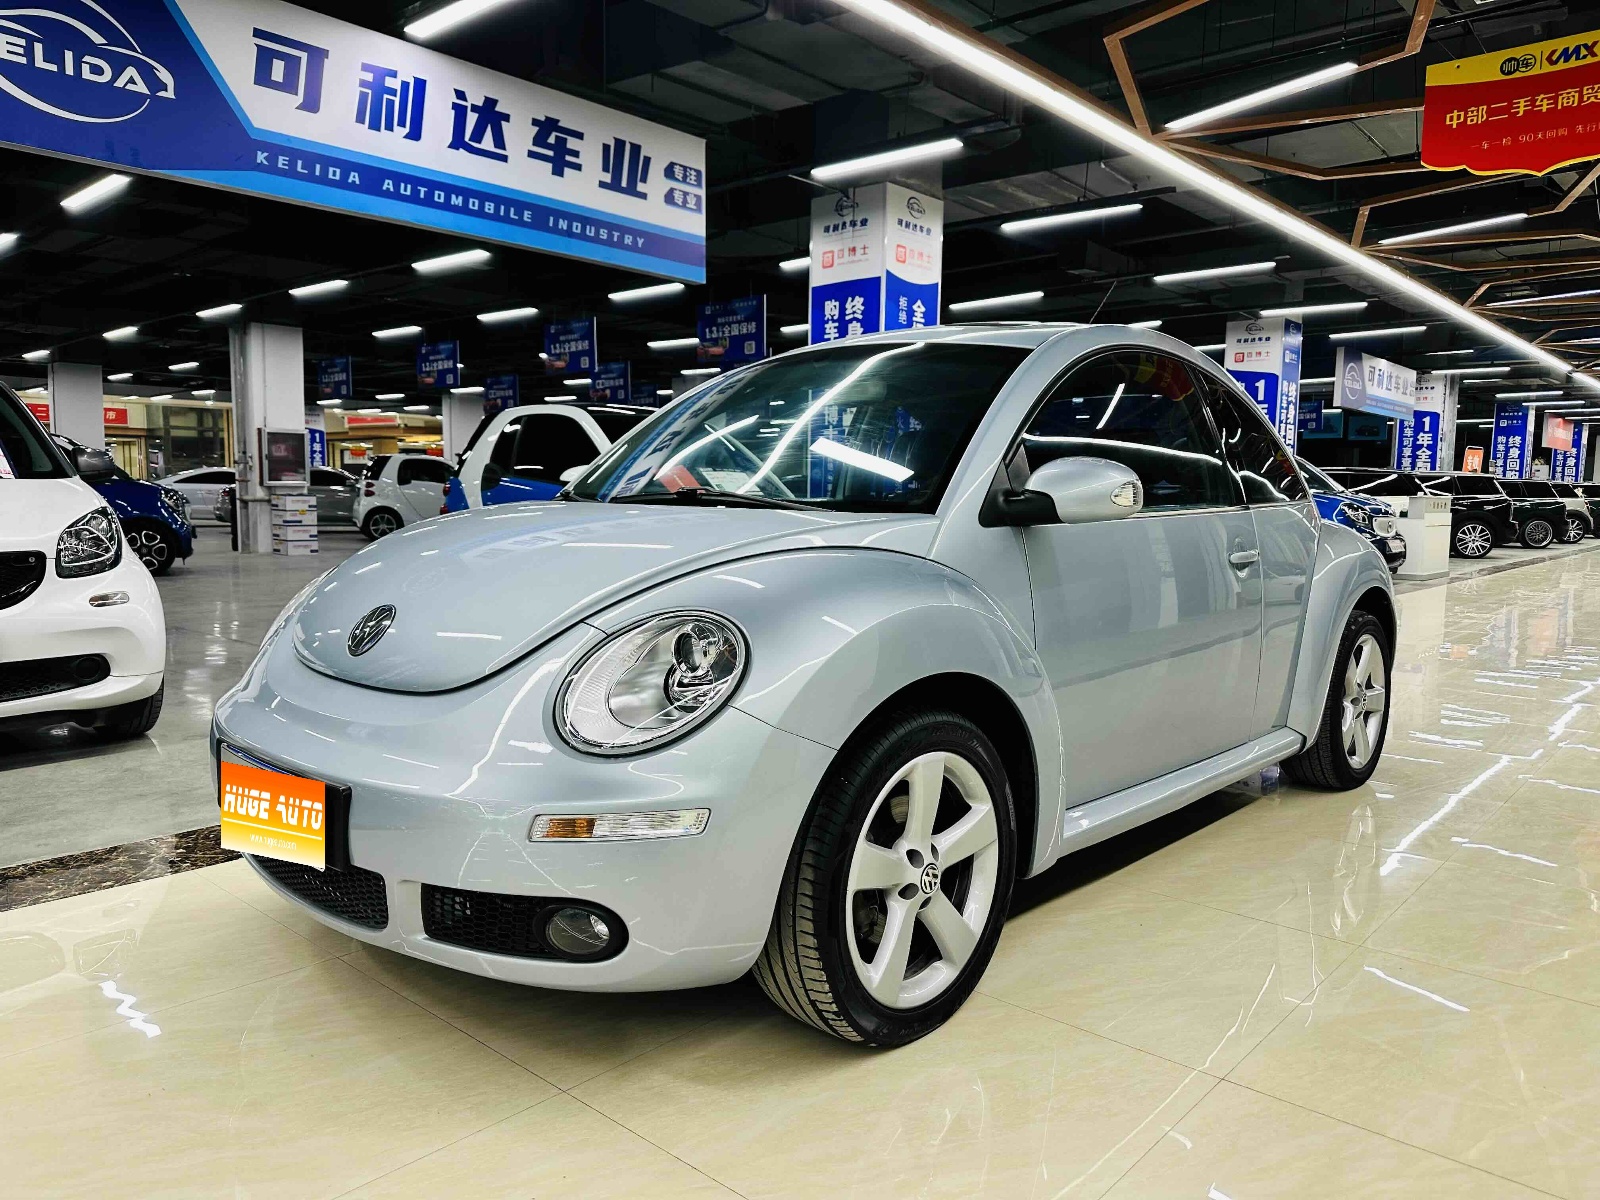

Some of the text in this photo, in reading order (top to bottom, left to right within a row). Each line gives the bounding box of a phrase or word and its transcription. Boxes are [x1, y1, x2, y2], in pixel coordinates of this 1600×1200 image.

[252, 27, 651, 200] 可利达车业
[1575, 122, 1600, 134] 先行
[672, 164, 699, 186] 专注
[256, 150, 646, 249] KELIDA AUTOMOBILE INDUSTRY
[672, 189, 699, 210] 专业
